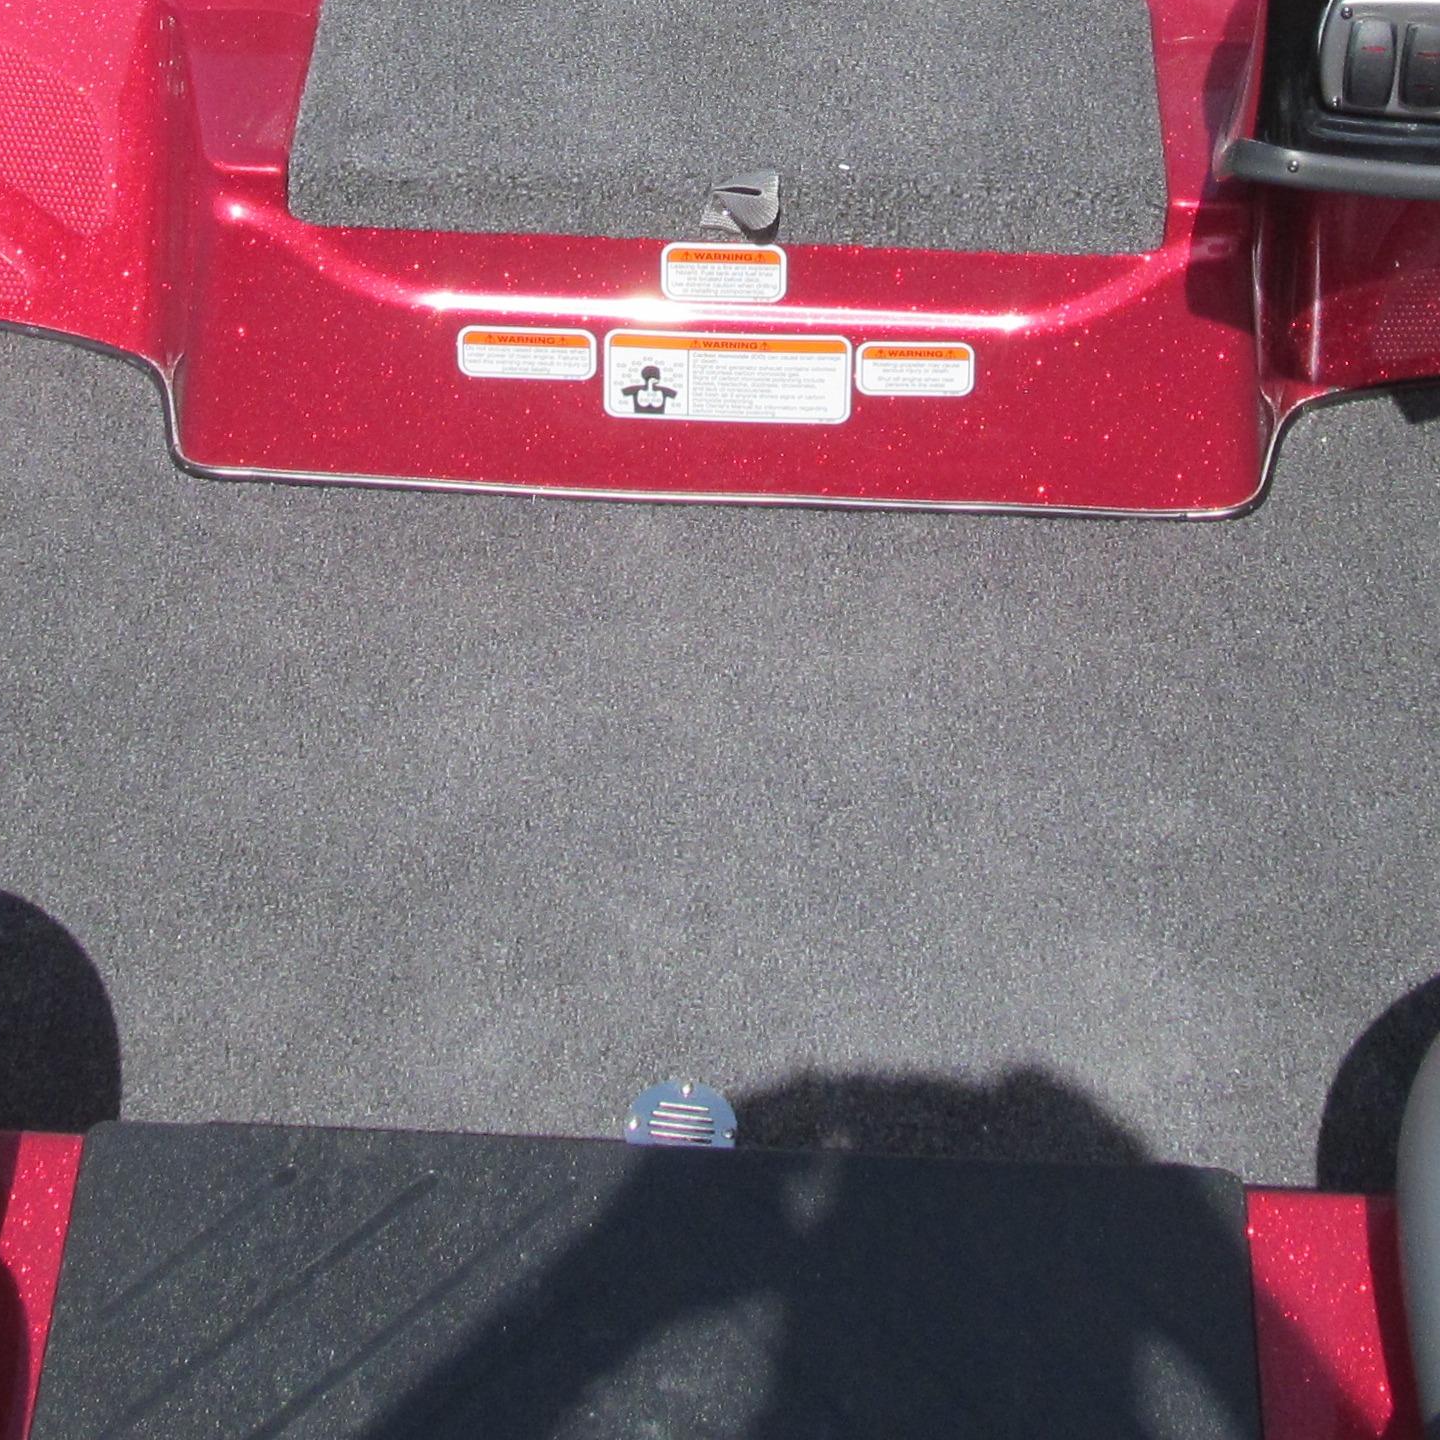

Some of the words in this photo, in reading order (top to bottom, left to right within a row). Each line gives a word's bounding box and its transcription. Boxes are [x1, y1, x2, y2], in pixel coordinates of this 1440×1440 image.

[693, 252, 754, 262] WARNING
[497, 335, 556, 345] WARNING
[702, 340, 759, 350] WARNING
[888, 349, 944, 358] WARNING
